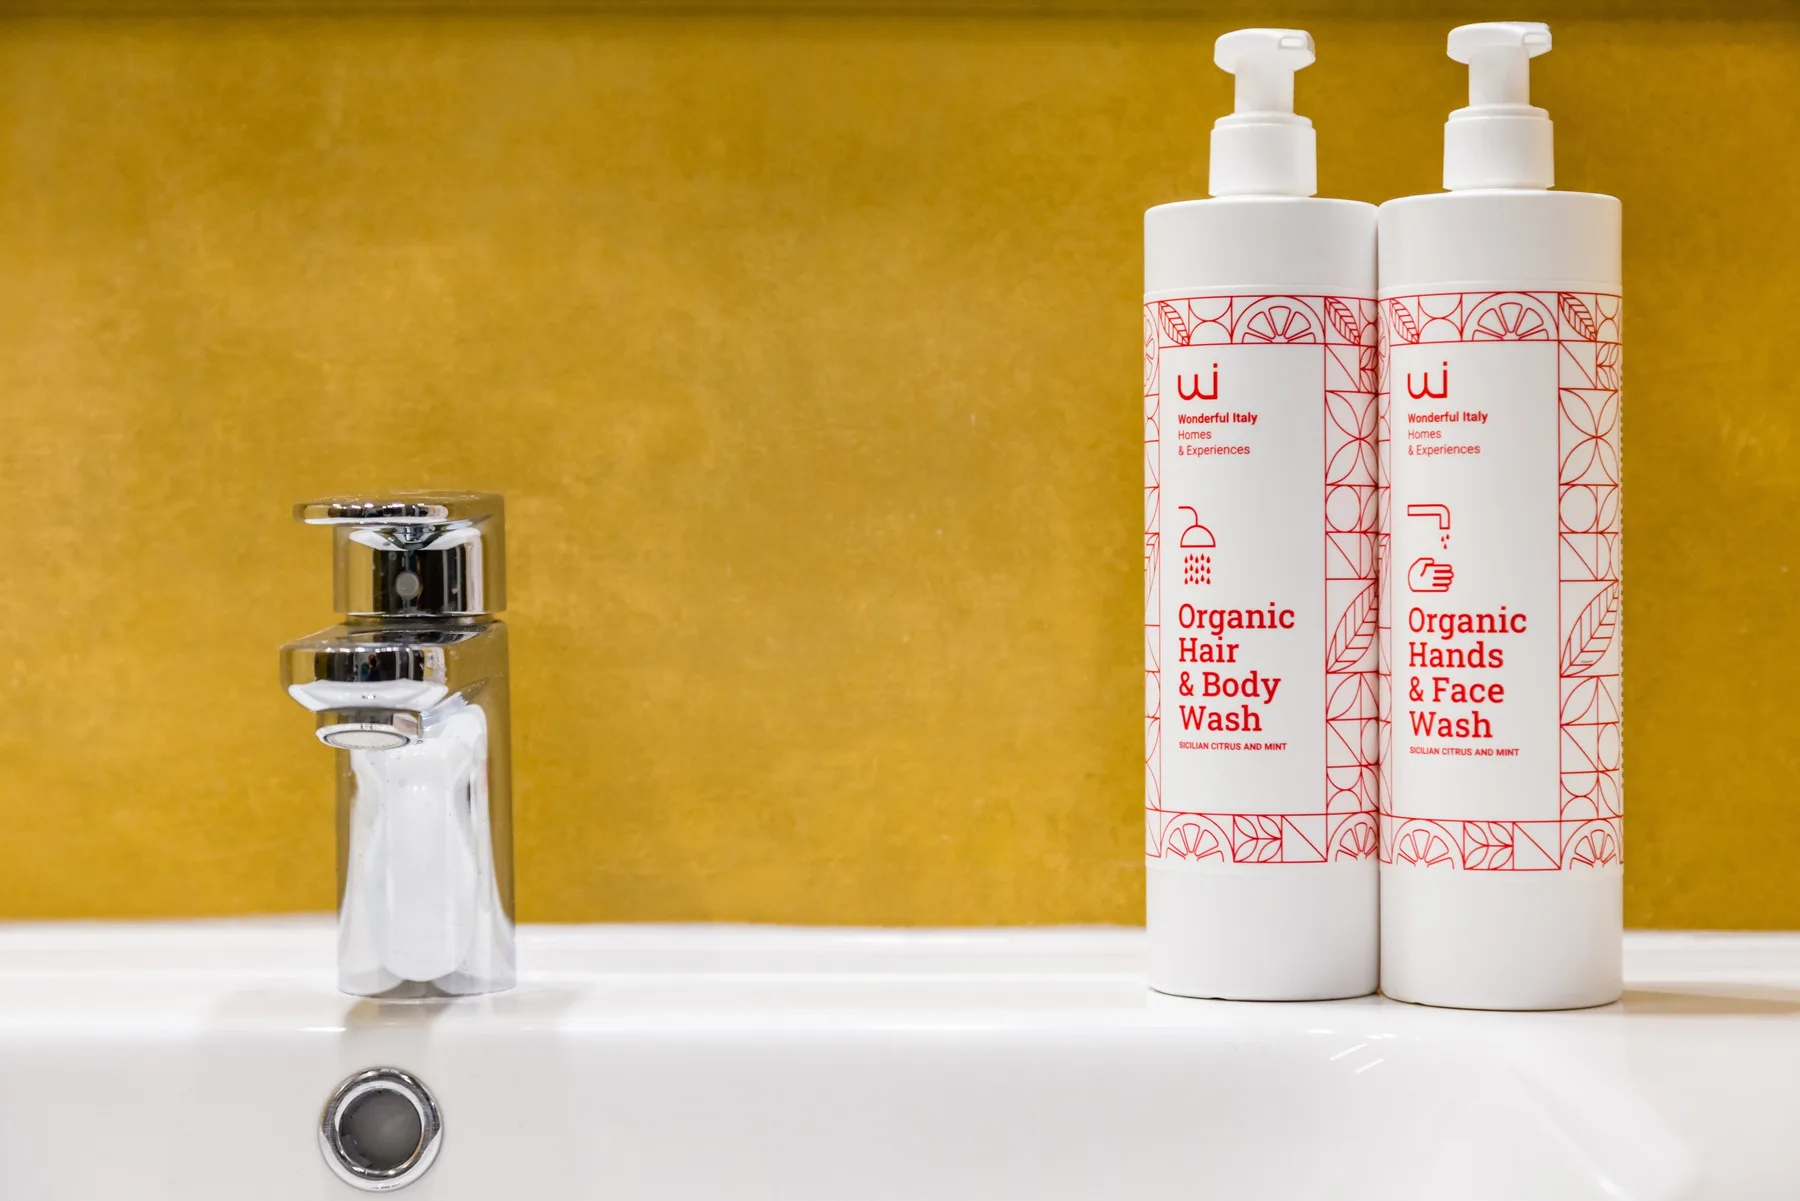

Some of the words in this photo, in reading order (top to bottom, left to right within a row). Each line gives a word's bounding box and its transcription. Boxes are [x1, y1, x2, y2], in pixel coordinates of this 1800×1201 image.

[1178, 413, 1231, 426] Wonderful
[1232, 411, 1259, 426] Italy
[1407, 412, 1460, 425] Wonderful
[1462, 411, 1489, 425] Italy
[1177, 430, 1212, 440] Homes
[1407, 429, 1442, 439] Homes
[1177, 446, 1185, 457] &
[1186, 444, 1251, 457] Experiences
[1407, 446, 1415, 457] &
[1416, 443, 1481, 457] Experiences
[1178, 601, 1296, 636] Organic
[1408, 605, 1528, 641] Organic
[1178, 636, 1240, 664] Hair
[1408, 640, 1505, 669] Hands
[1178, 671, 1194, 698] &
[1201, 670, 1282, 705] Body
[1408, 675, 1425, 703] &
[1431, 676, 1505, 705] Face
[1178, 704, 1263, 733] Wash
[1408, 709, 1494, 739] Wash
[1178, 741, 1209, 751] SICILIAN
[1211, 742, 1242, 752] CITRUS
[1243, 742, 1263, 752] AND
[1263, 742, 1287, 752] MINT
[1409, 746, 1441, 756] SICILIAN
[1442, 747, 1473, 757] CITRUS
[1474, 747, 1494, 757] AND
[1495, 747, 1519, 757] MINT
